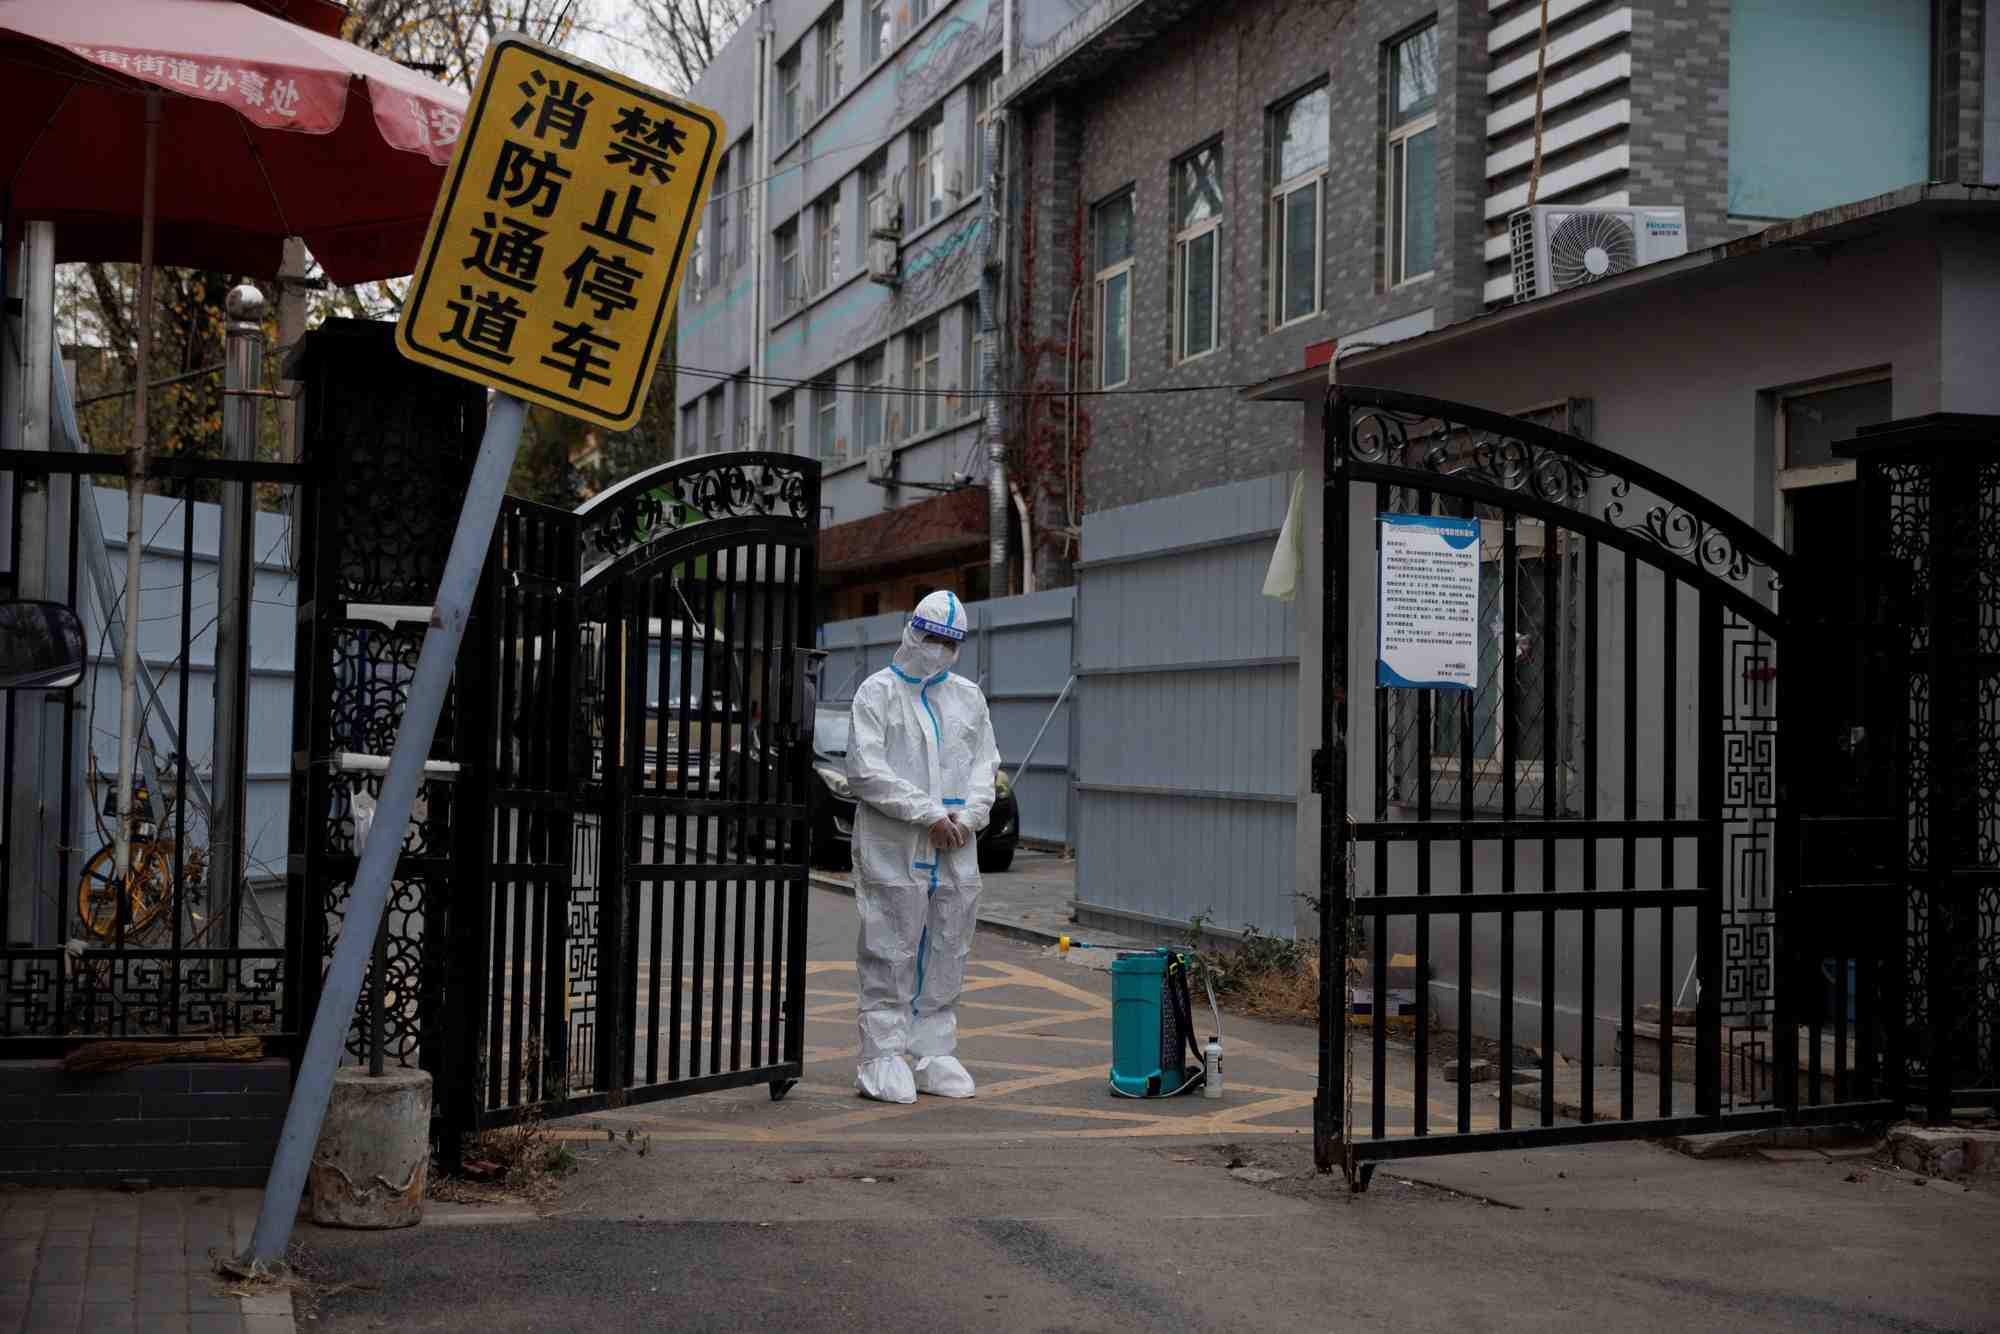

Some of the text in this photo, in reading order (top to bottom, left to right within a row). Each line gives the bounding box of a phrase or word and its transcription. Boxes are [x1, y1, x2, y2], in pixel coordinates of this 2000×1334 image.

[440, 69, 593, 365] 消防通道
[540, 106, 687, 390] 禁止停车
